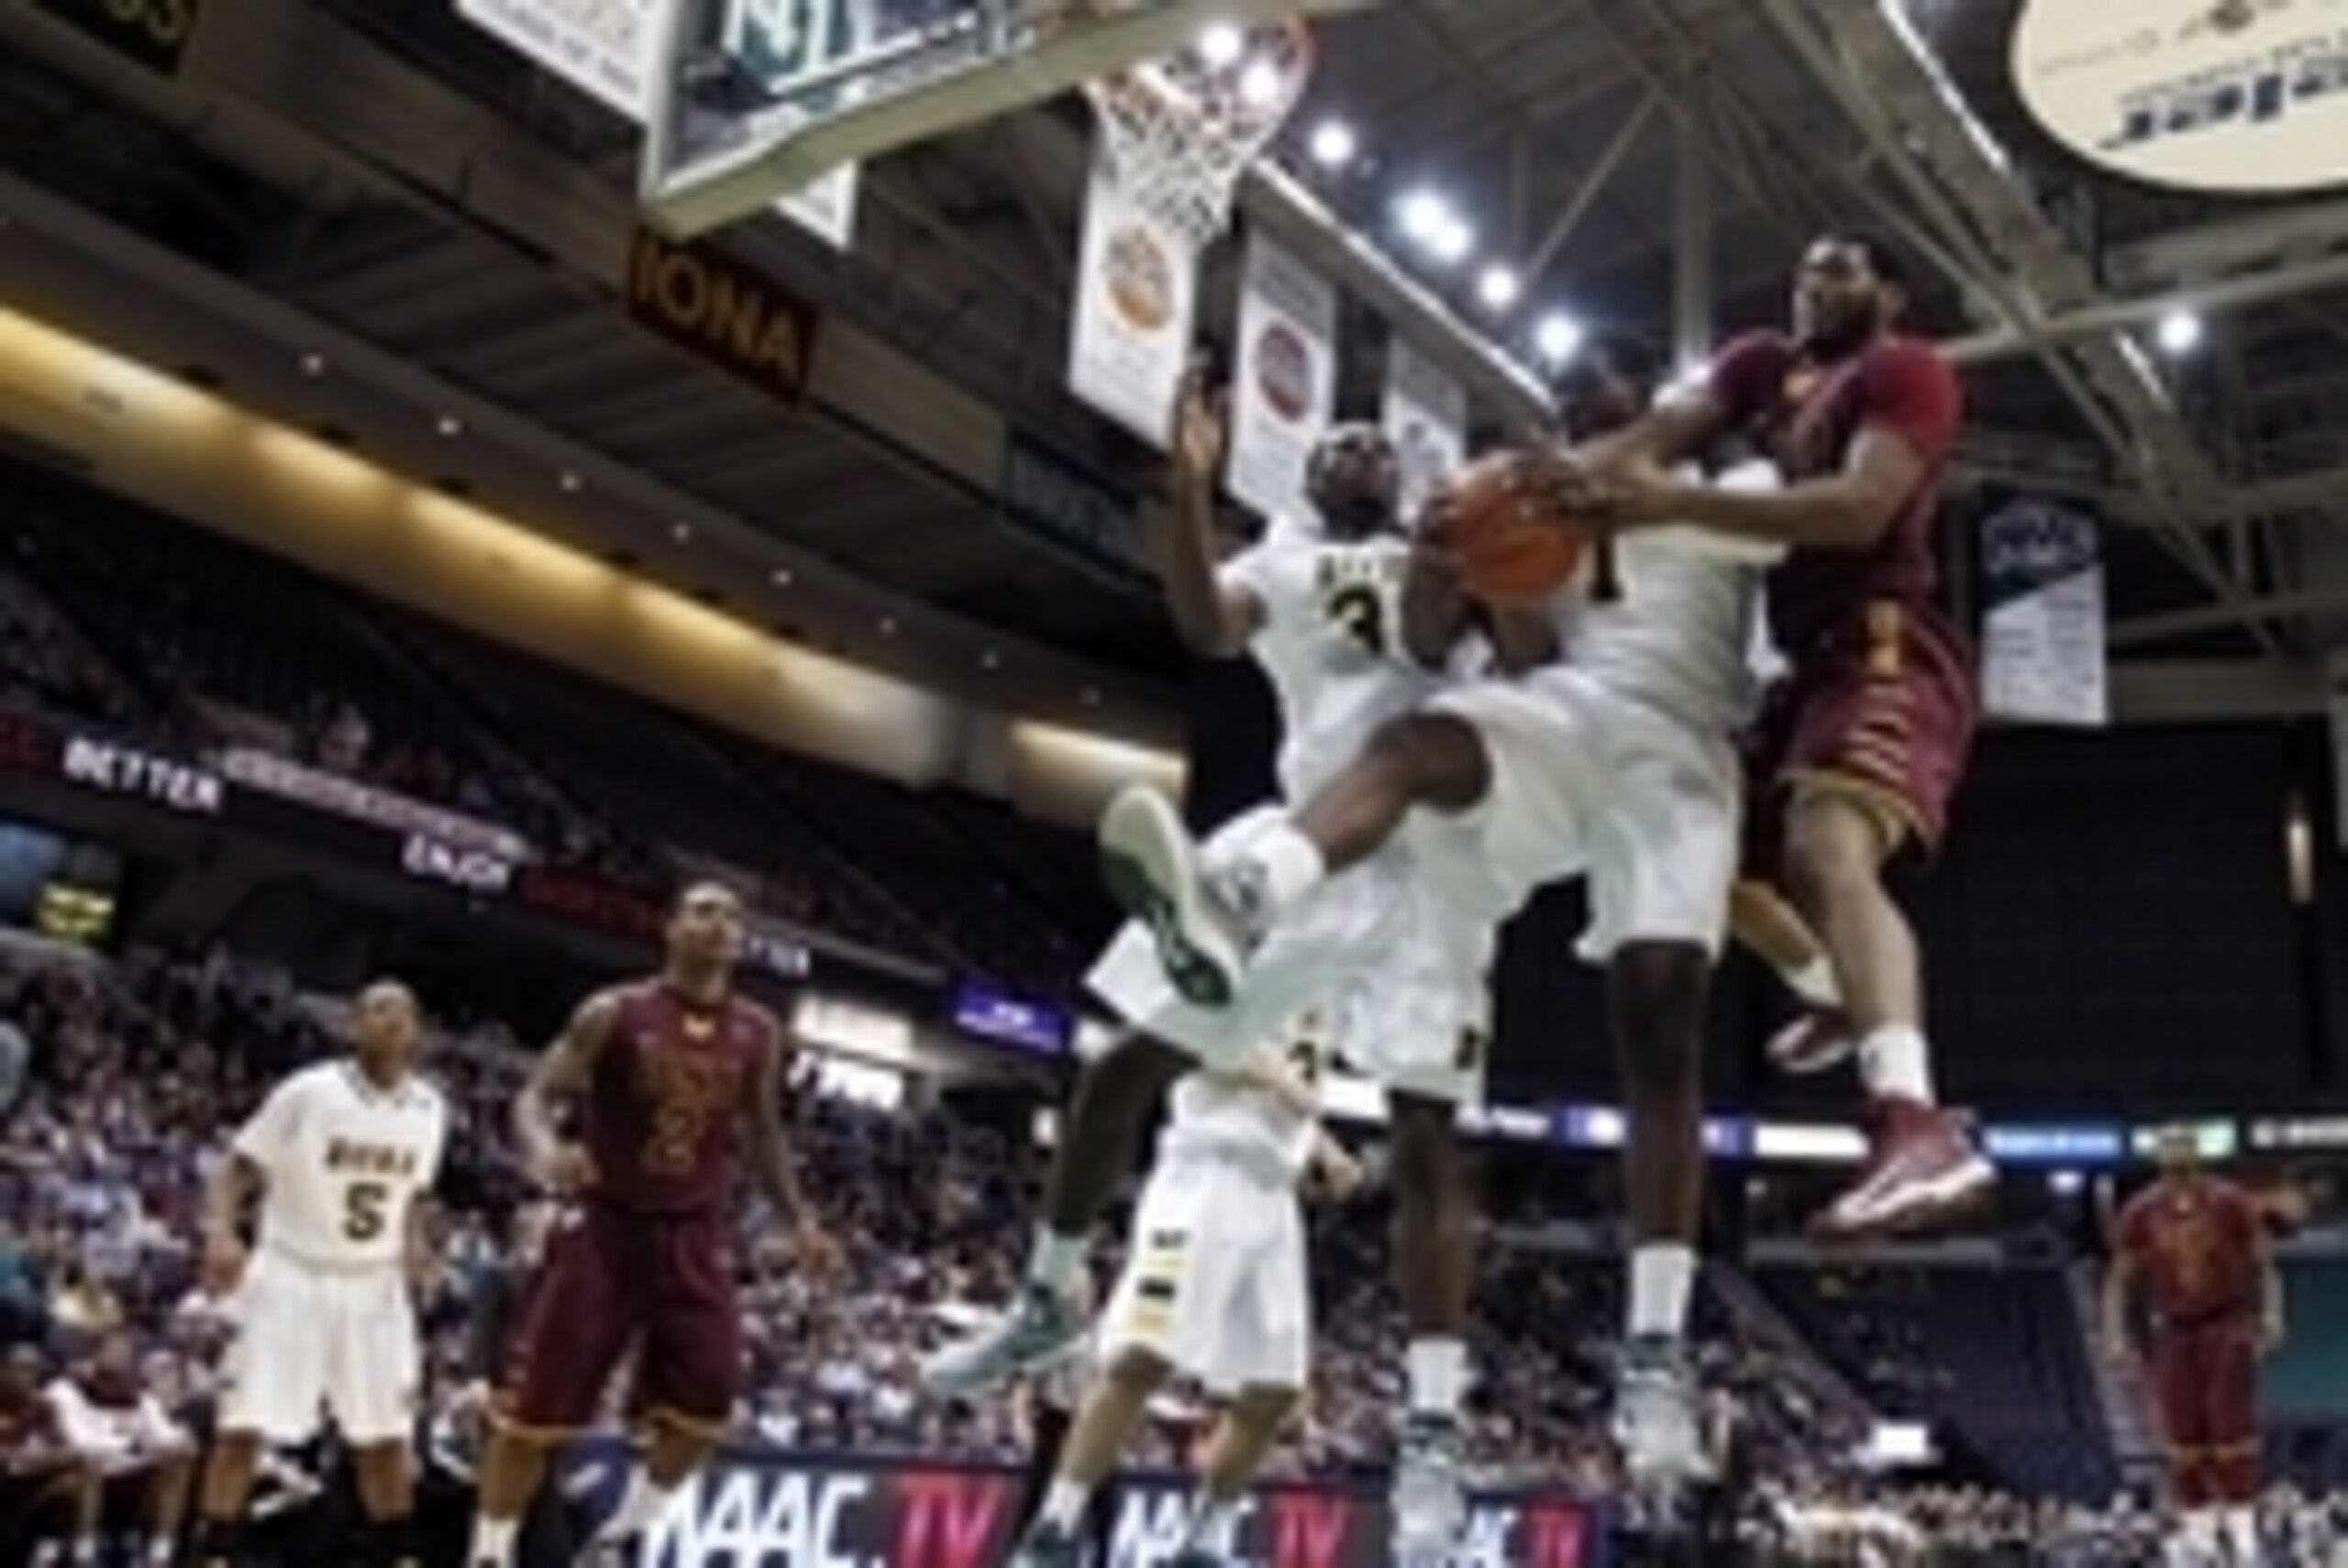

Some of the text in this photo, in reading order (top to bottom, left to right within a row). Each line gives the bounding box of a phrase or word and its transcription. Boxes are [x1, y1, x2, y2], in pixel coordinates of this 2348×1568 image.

[638, 237, 802, 387] IONA
[65, 736, 219, 812] BETTER
[343, 1180, 388, 1242] 5
